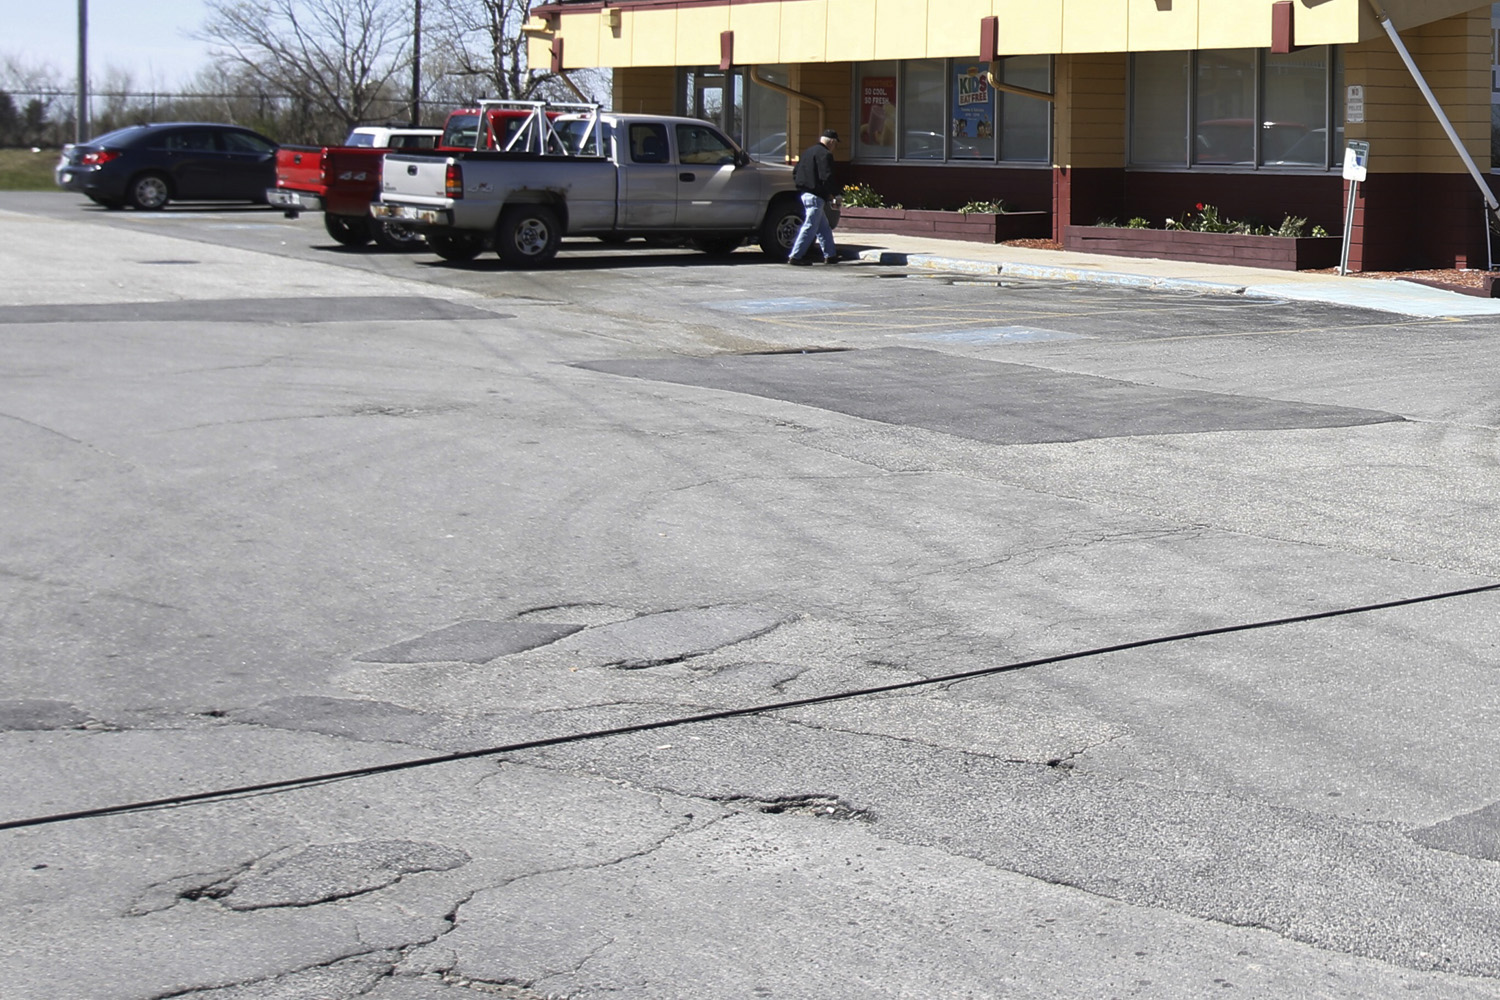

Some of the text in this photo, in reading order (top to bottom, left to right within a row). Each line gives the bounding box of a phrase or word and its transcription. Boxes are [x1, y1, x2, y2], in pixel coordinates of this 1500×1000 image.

[959, 74, 987, 95] KIDS
[959, 91, 987, 105] EAT FREE
